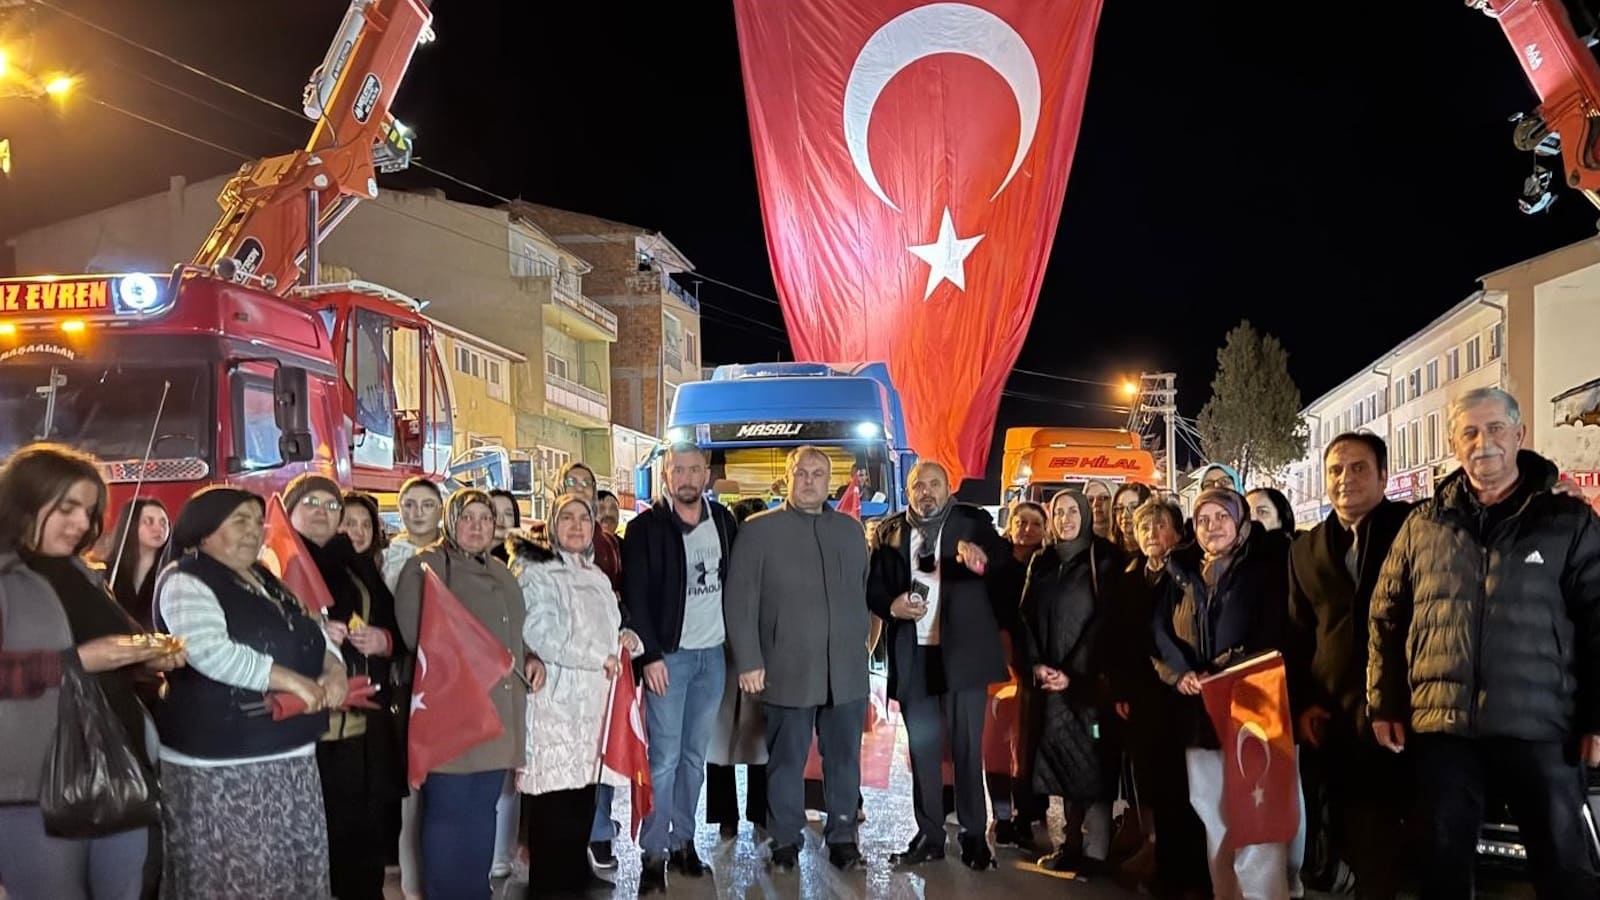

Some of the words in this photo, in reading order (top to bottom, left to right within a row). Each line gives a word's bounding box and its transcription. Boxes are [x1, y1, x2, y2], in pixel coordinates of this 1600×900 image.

[25, 280, 108, 309] EVREN
[736, 423, 804, 438] MASALI
[1048, 456, 1079, 469] ES
[1079, 455, 1141, 470] HİLAL
